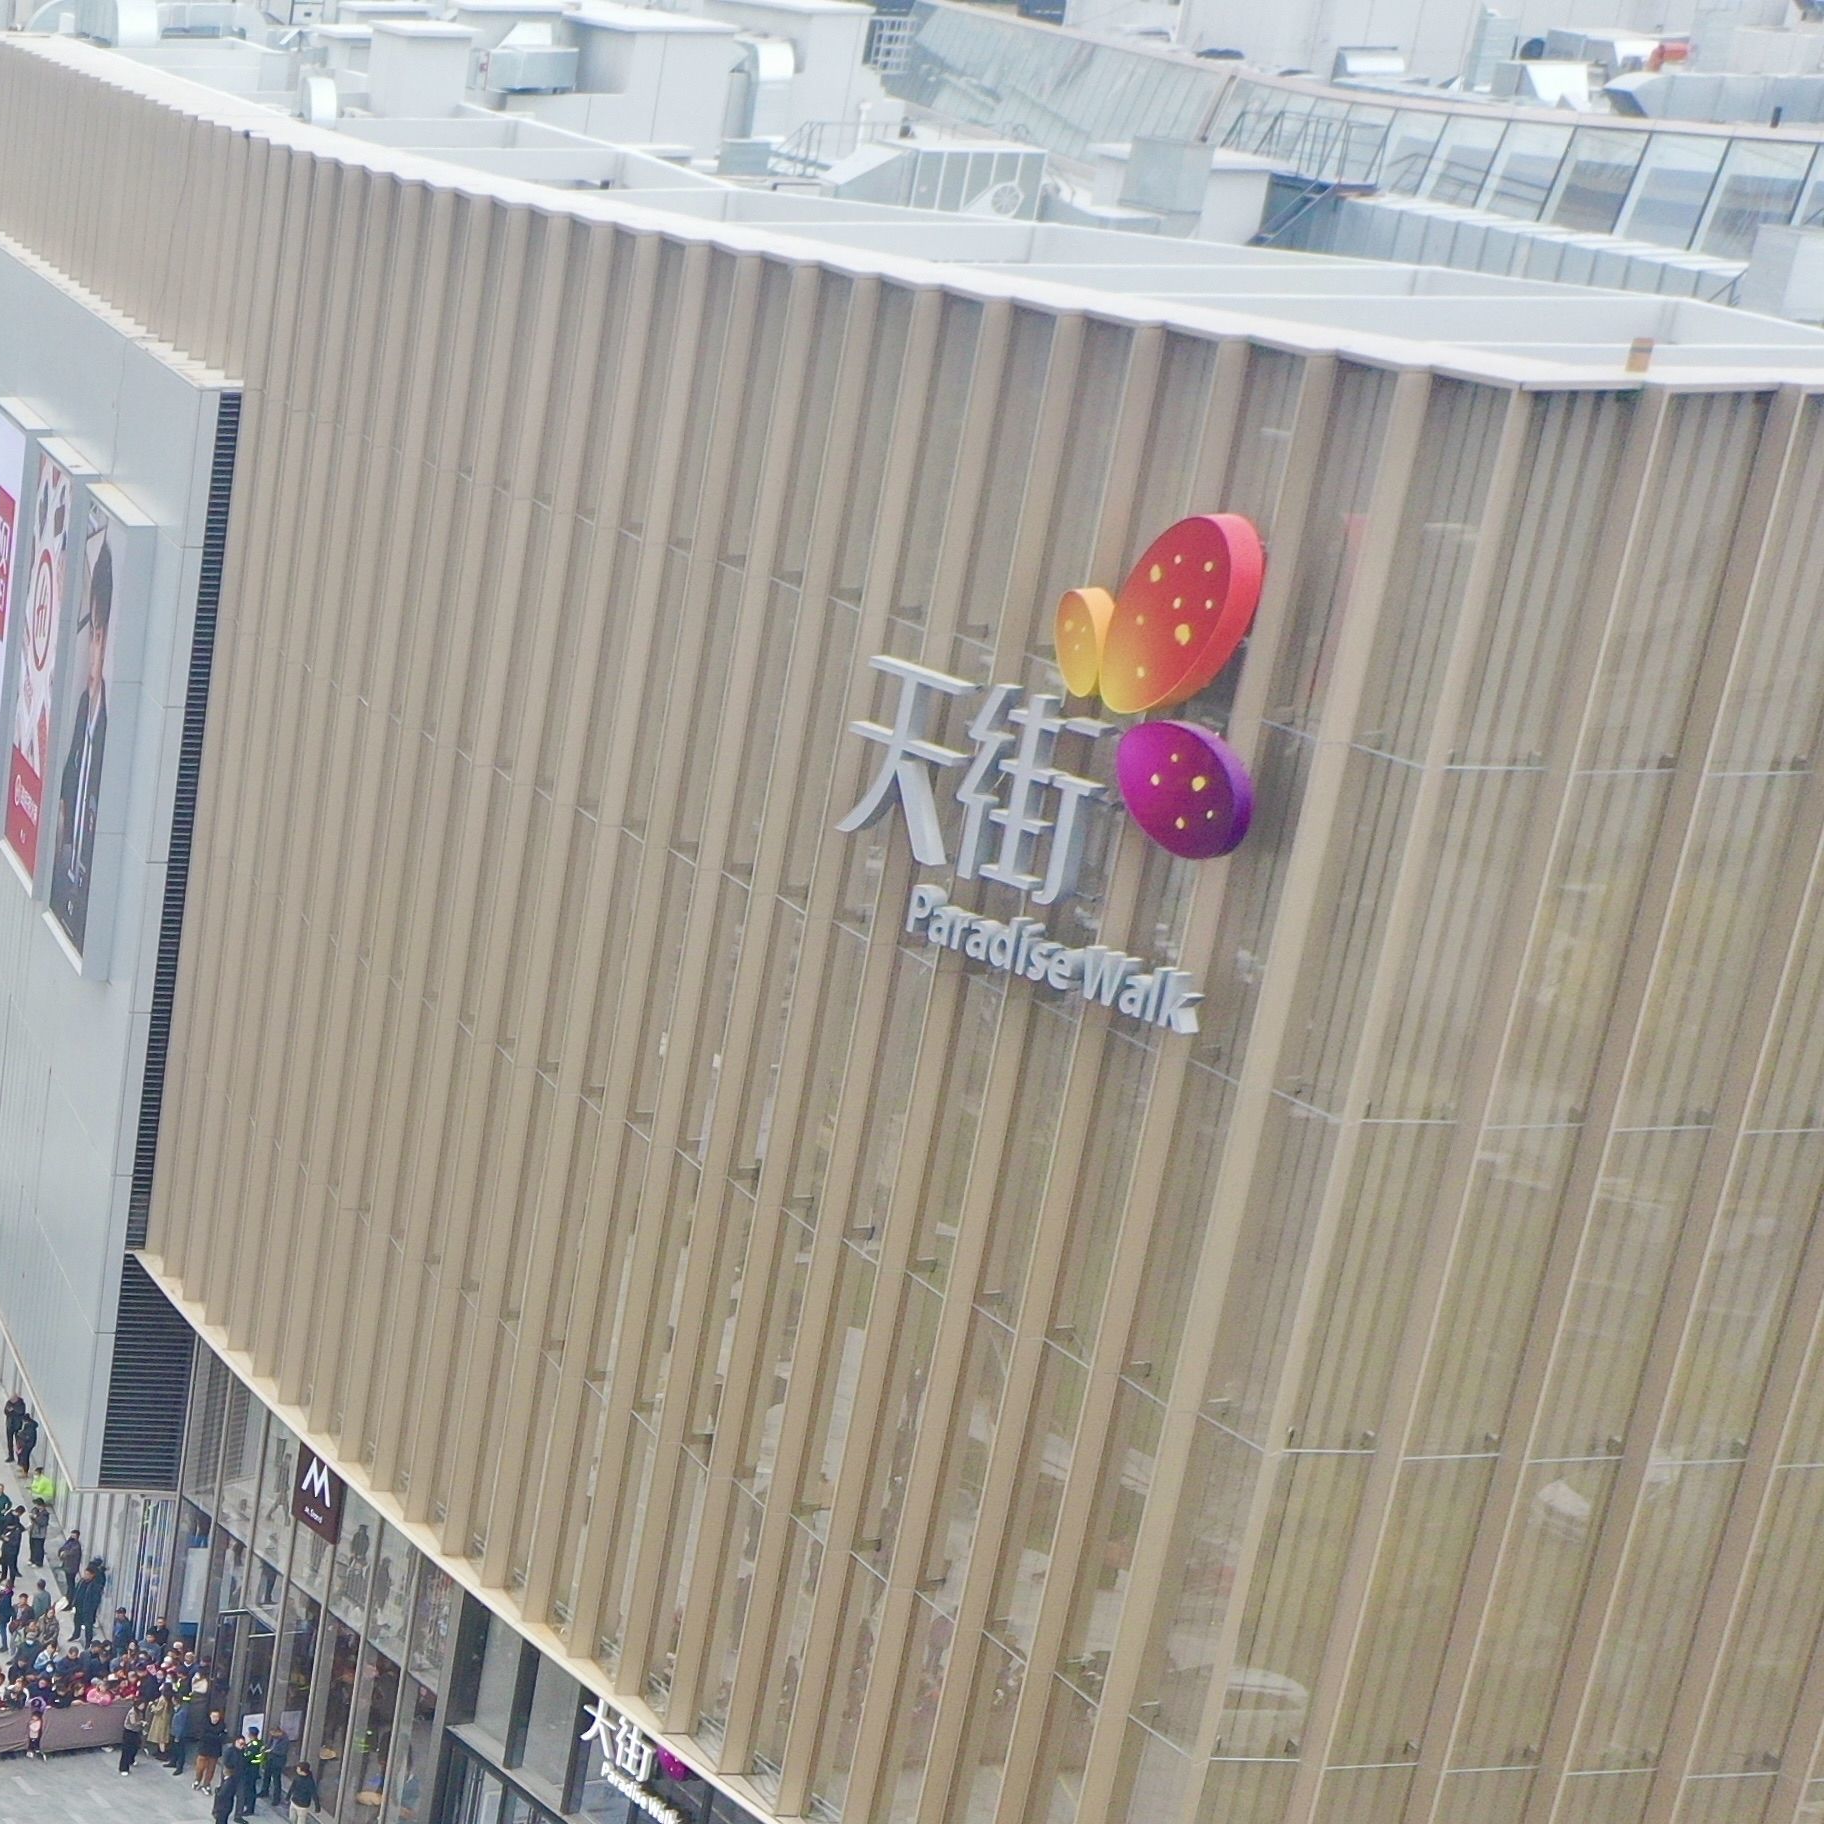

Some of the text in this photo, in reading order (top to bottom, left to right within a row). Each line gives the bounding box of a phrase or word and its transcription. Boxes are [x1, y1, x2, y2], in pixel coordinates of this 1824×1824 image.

[835, 655, 1122, 906] 天街
[906, 883, 1205, 1035] Paradise Walk
